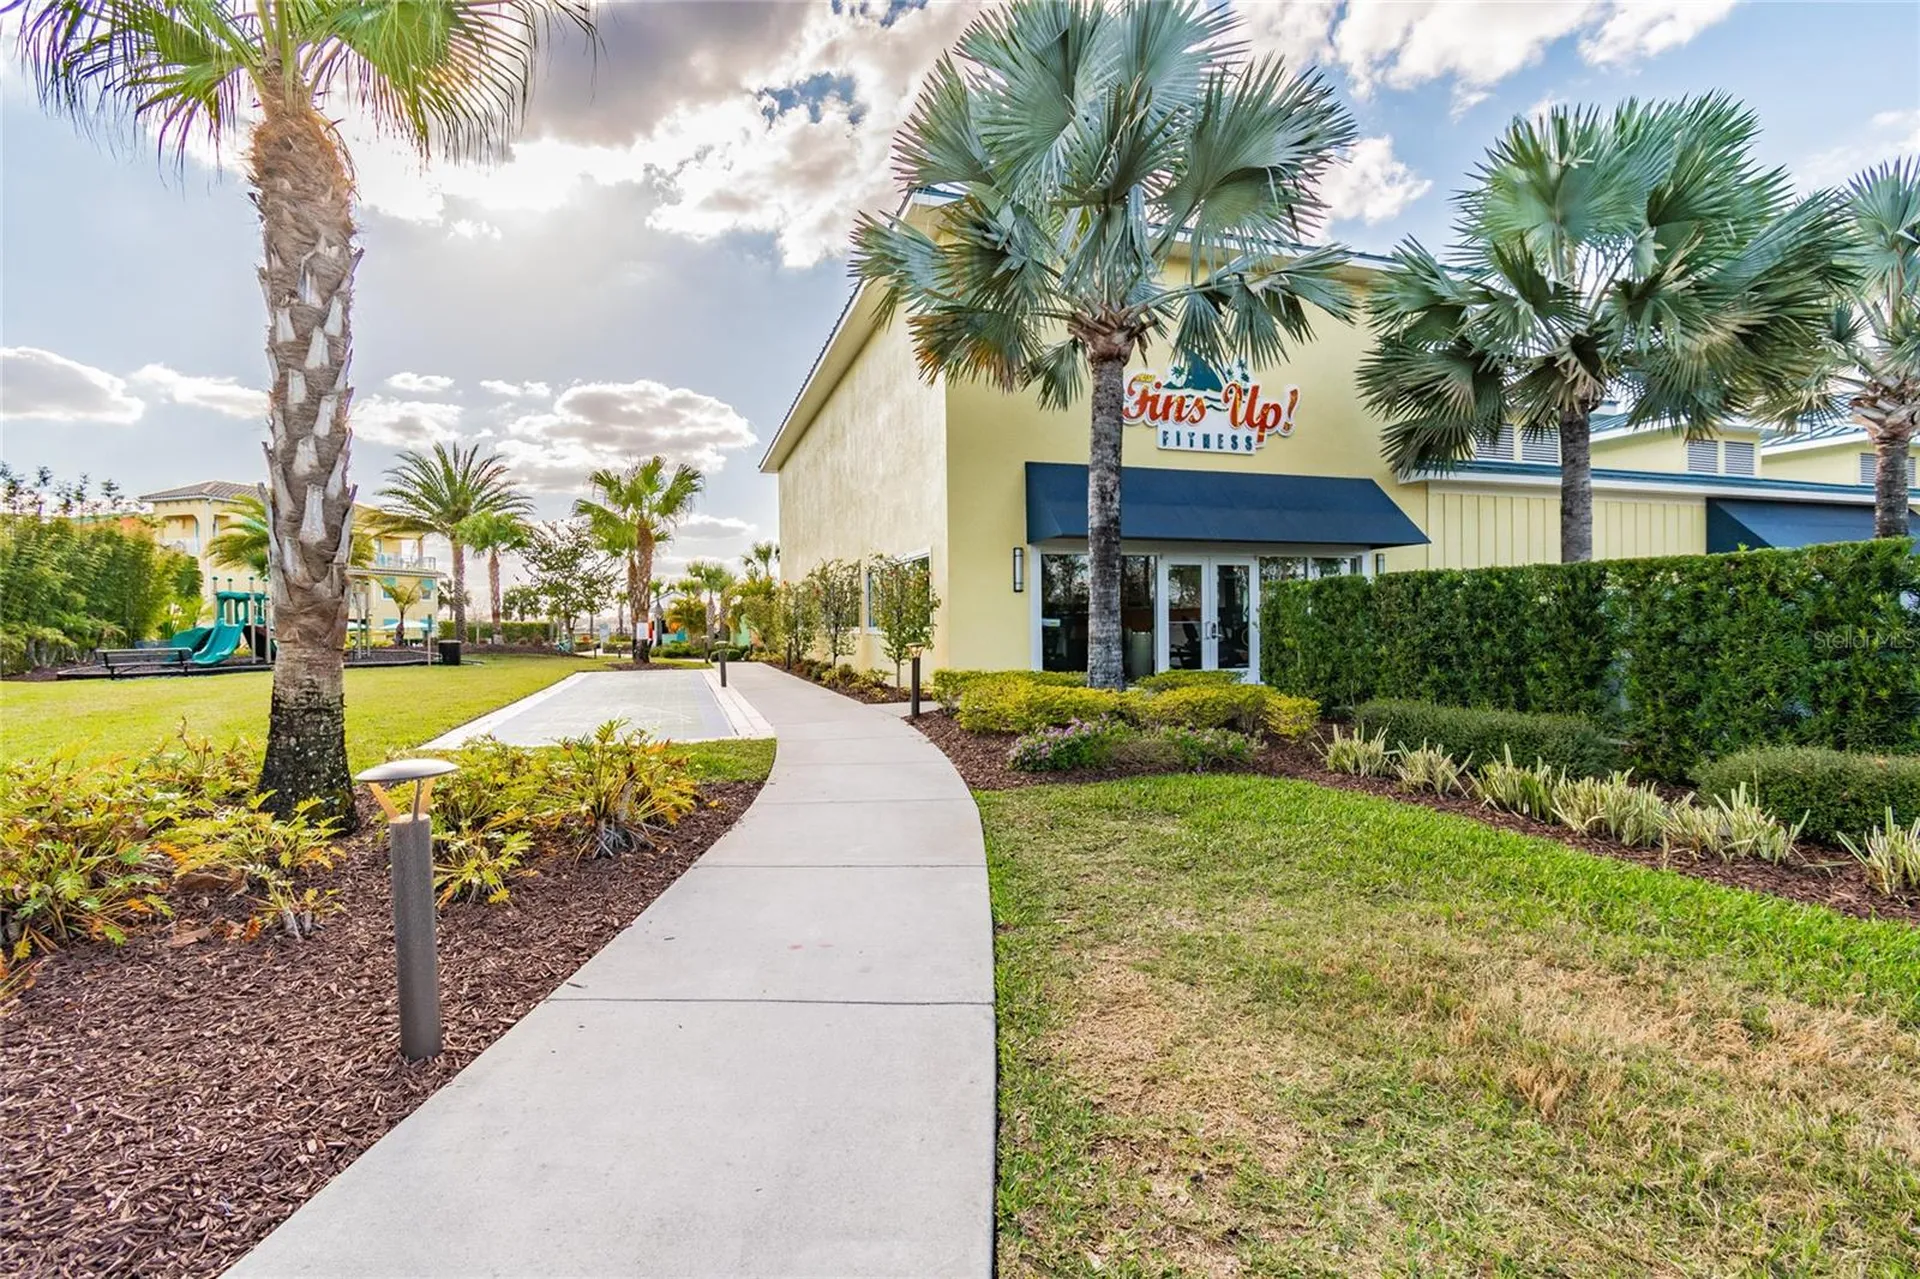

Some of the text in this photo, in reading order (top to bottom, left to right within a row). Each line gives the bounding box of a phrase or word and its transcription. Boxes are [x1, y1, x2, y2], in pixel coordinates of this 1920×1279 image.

[1122, 373, 1300, 444] Fins Up!
[1161, 429, 1254, 451] FITNESS
